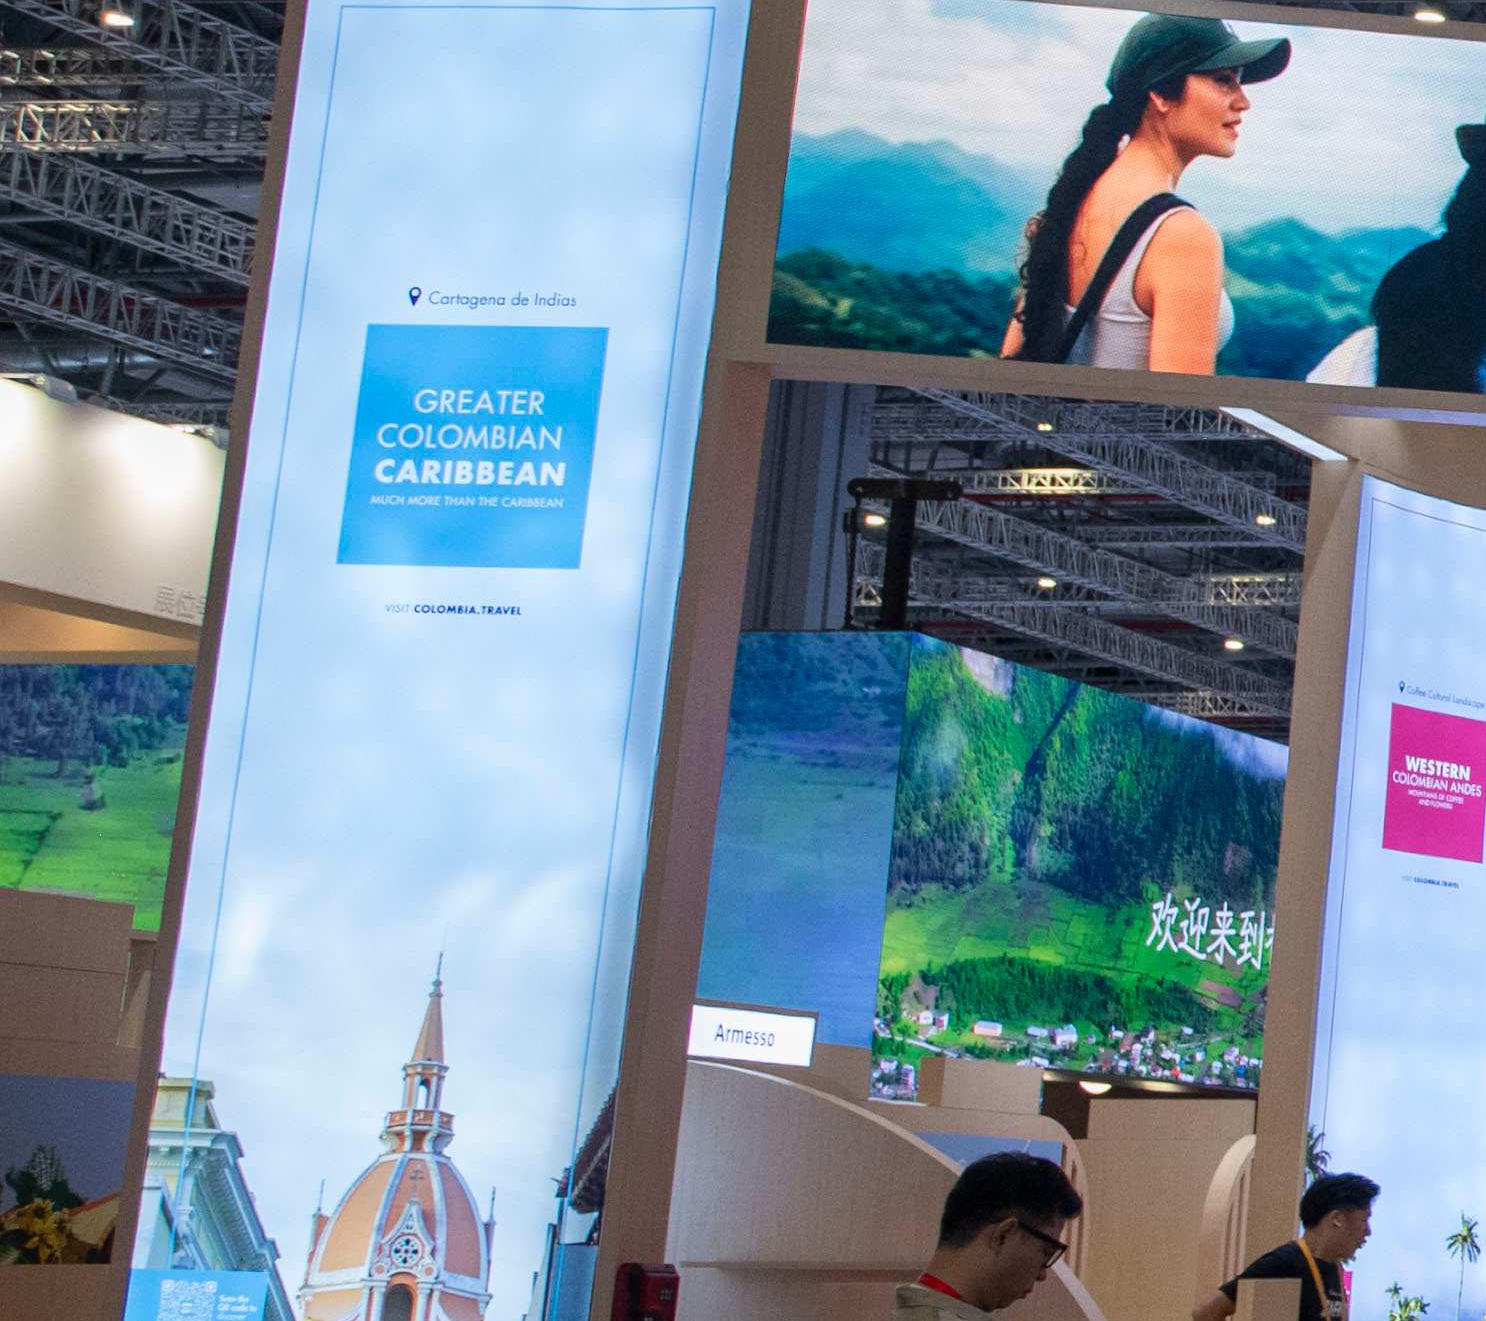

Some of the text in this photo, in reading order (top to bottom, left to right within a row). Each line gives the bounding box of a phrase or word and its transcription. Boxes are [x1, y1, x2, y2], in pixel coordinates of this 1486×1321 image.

[428, 291, 577, 309] Cartagena de Indias
[413, 388, 545, 416] GREATER
[377, 423, 562, 451] COLOMBIAN
[374, 458, 566, 487] CARIBBEAN
[370, 495, 564, 509] MUCH MORE THAN THE CARIBBEAN
[414, 604, 522, 616] COLOMBIA.TRAVEL
[1407, 685, 1426, 698] Coffee
[1405, 755, 1471, 781] WESTERN
[1392, 770, 1483, 797] COLOMBIAN ANDES
[714, 1023, 775, 1047] Armesso
